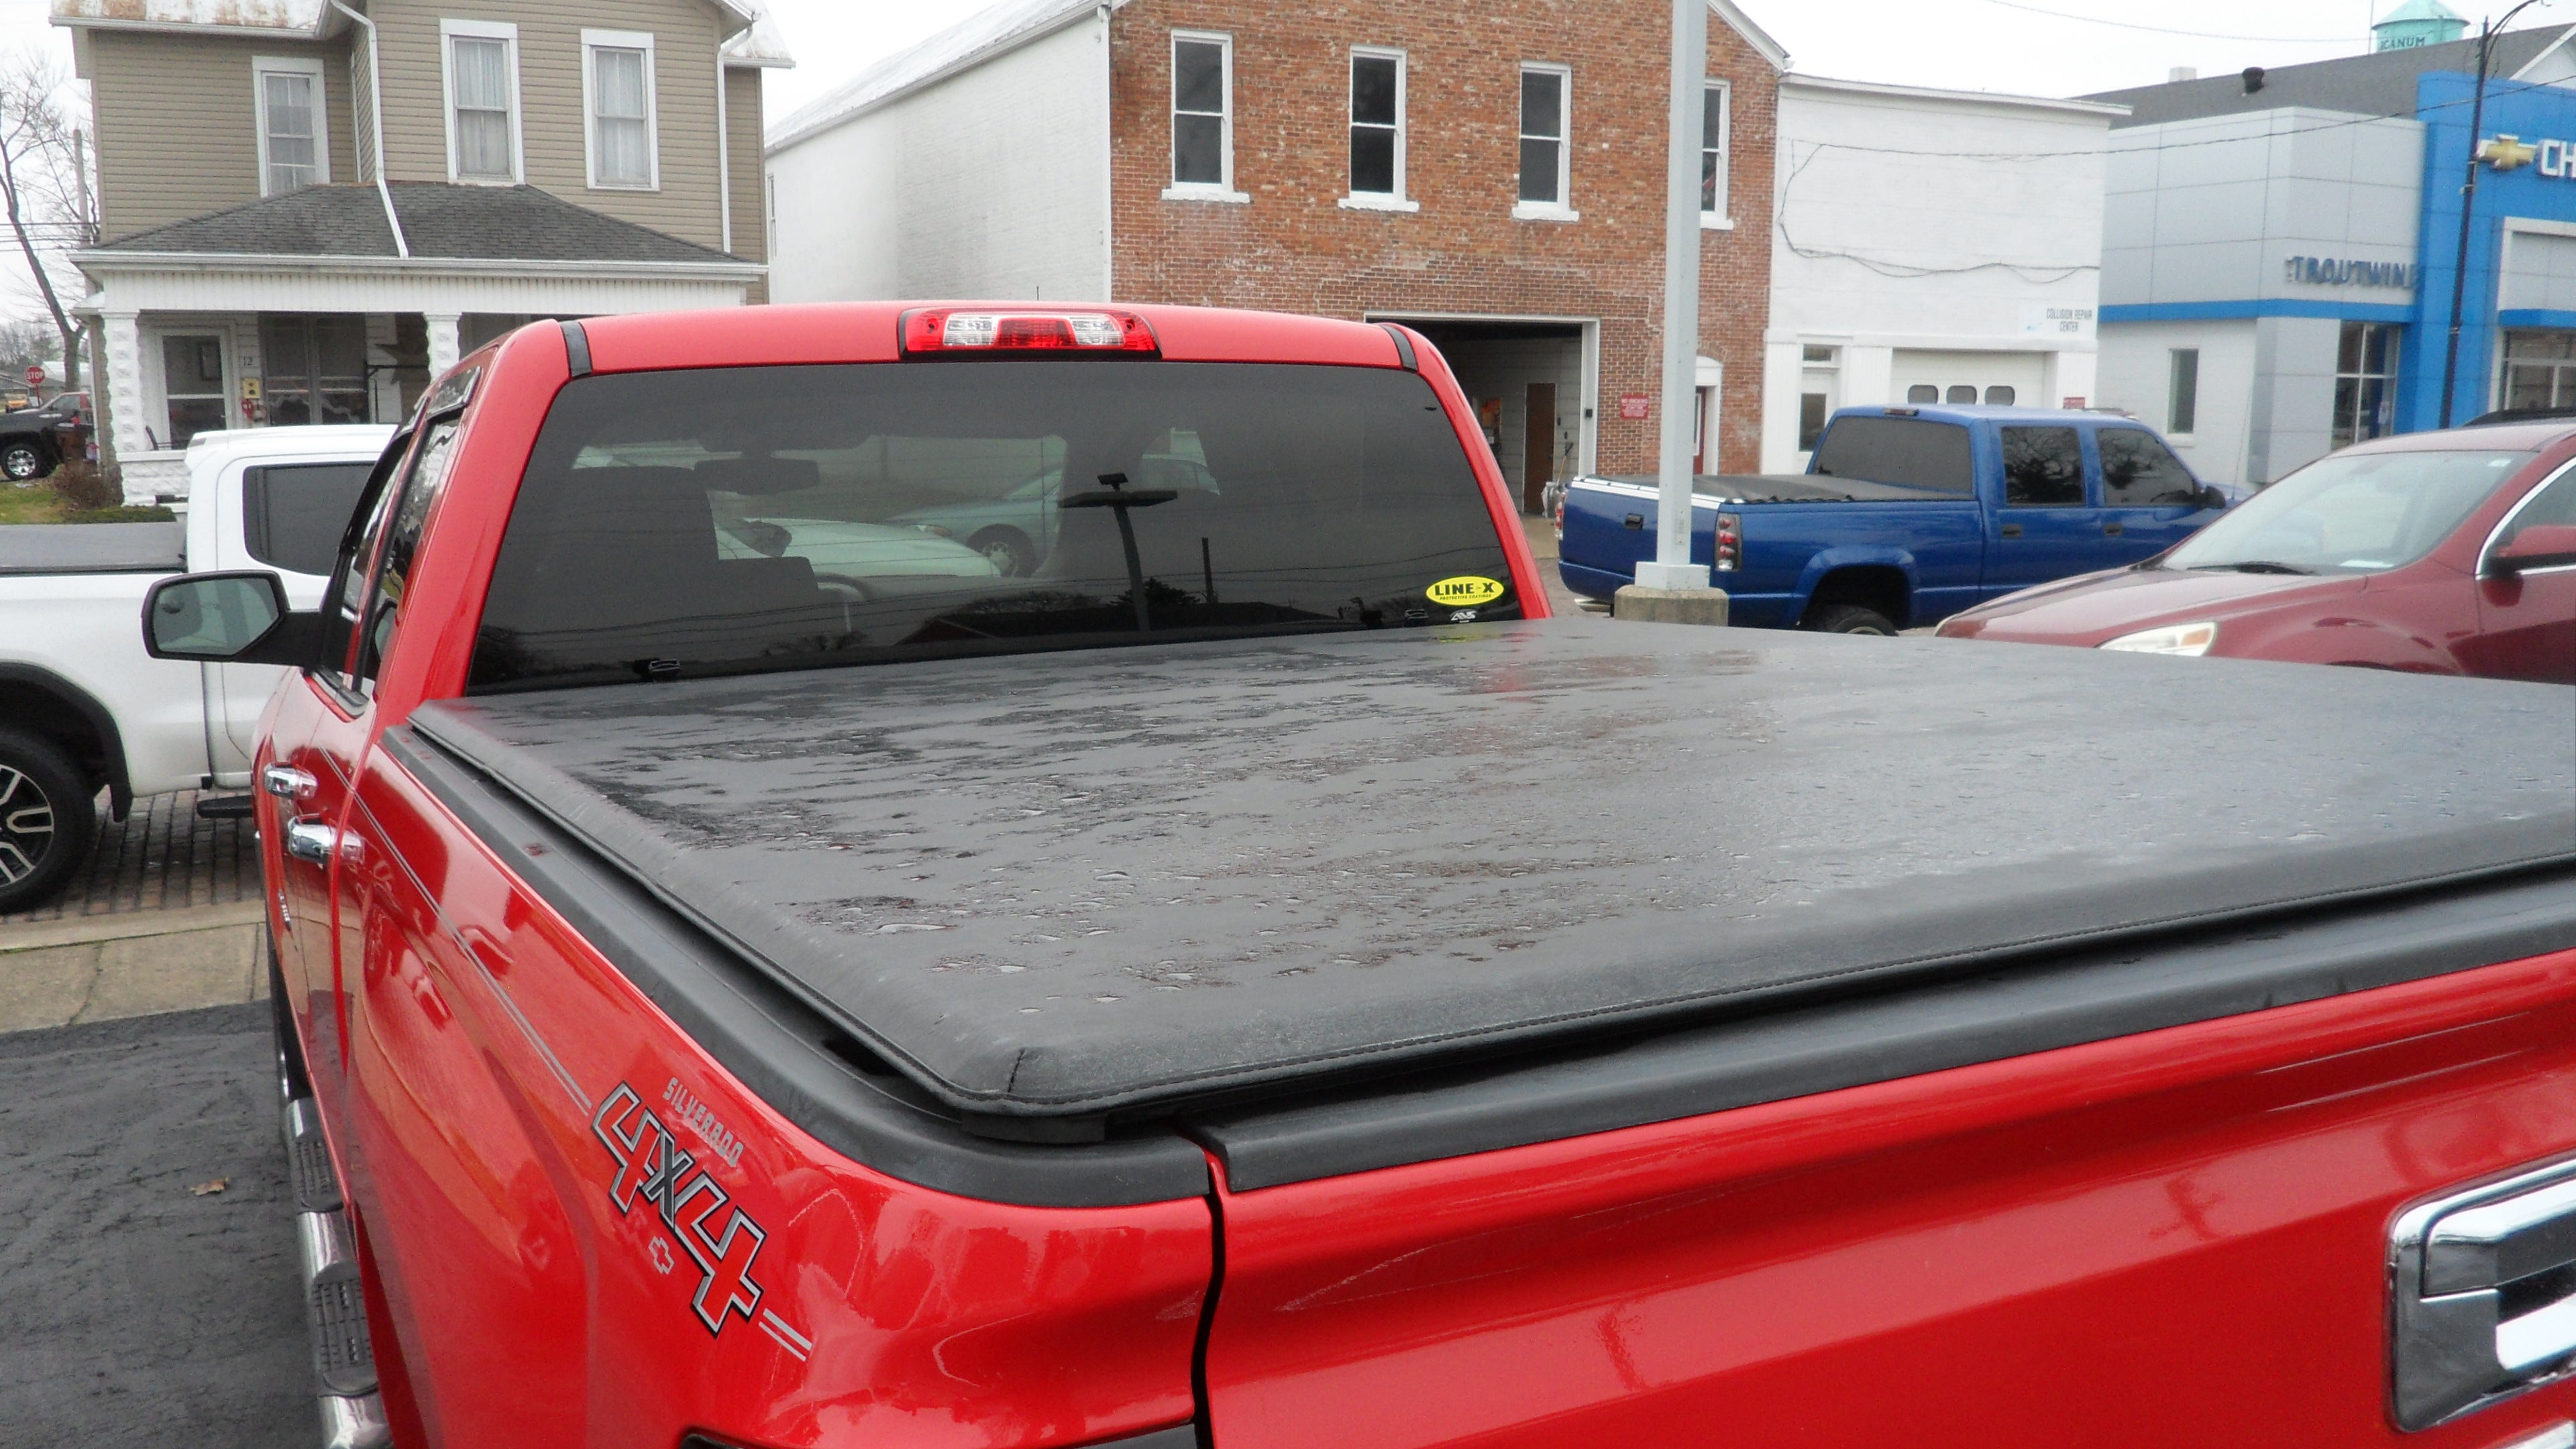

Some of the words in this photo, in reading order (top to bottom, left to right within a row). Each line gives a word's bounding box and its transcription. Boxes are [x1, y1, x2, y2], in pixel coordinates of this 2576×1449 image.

[2046, 308, 2073, 319] COLLISION
[2074, 309, 2092, 320] REPAIR
[2059, 321, 2078, 332] CENTER
[27, 371, 44, 380] STOP
[662, 1077, 745, 1167] SILVERADO
